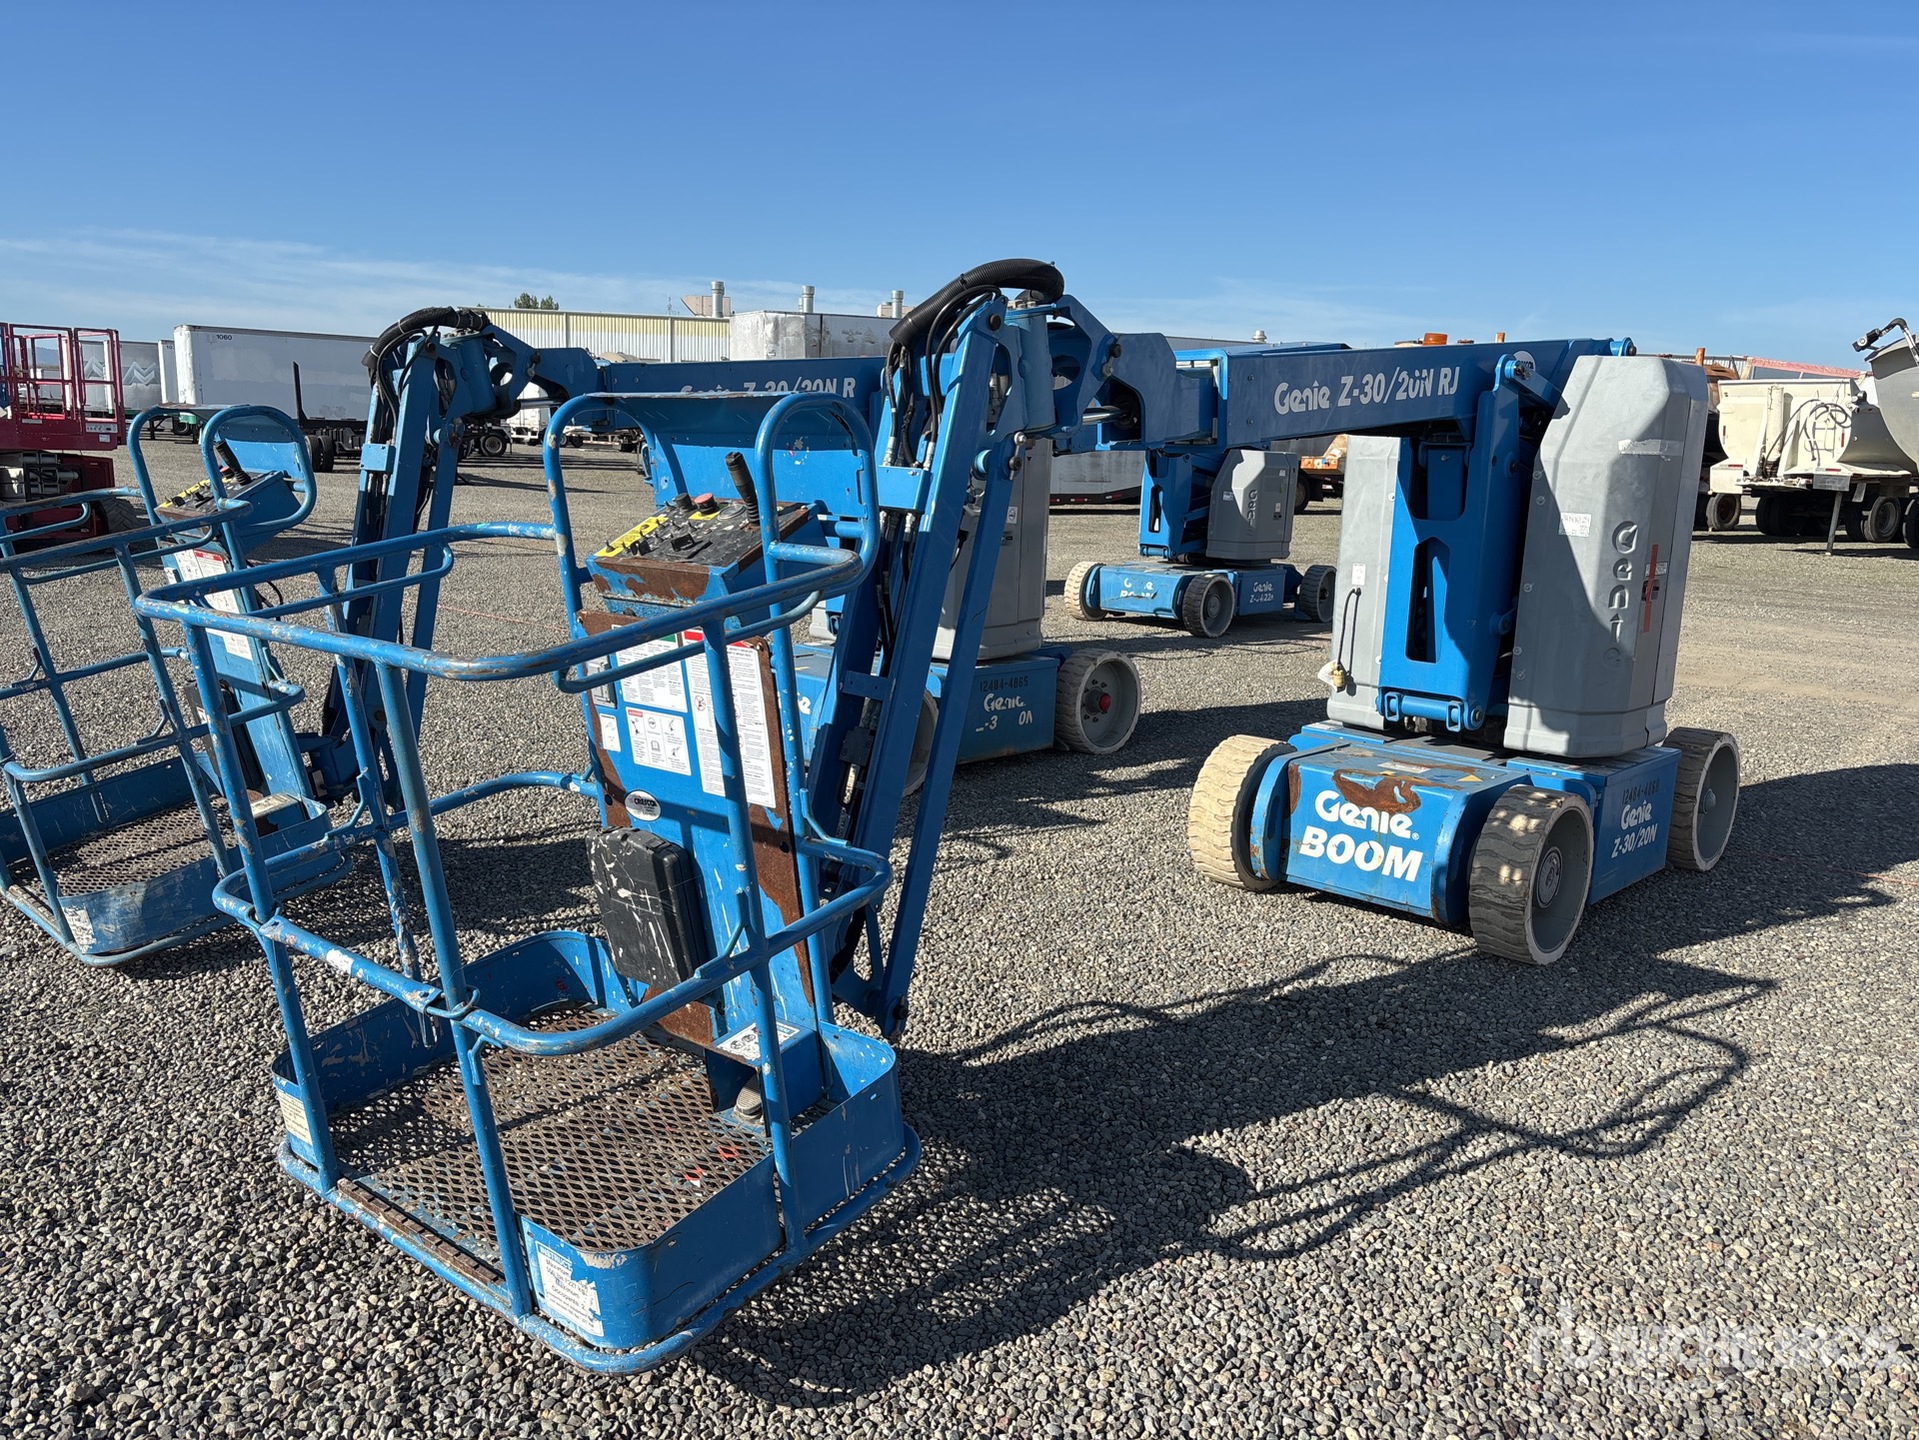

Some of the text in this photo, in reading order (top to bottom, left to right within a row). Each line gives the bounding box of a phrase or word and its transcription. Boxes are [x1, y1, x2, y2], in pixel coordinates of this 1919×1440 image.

[1274, 379, 1332, 415] Genie
[1438, 366, 1461, 397] RJ
[1315, 790, 1415, 840] Genie
[1620, 799, 1653, 831] Genie
[1299, 825, 1424, 883] BOOM
[1611, 823, 1659, 859] Z-30/20N
